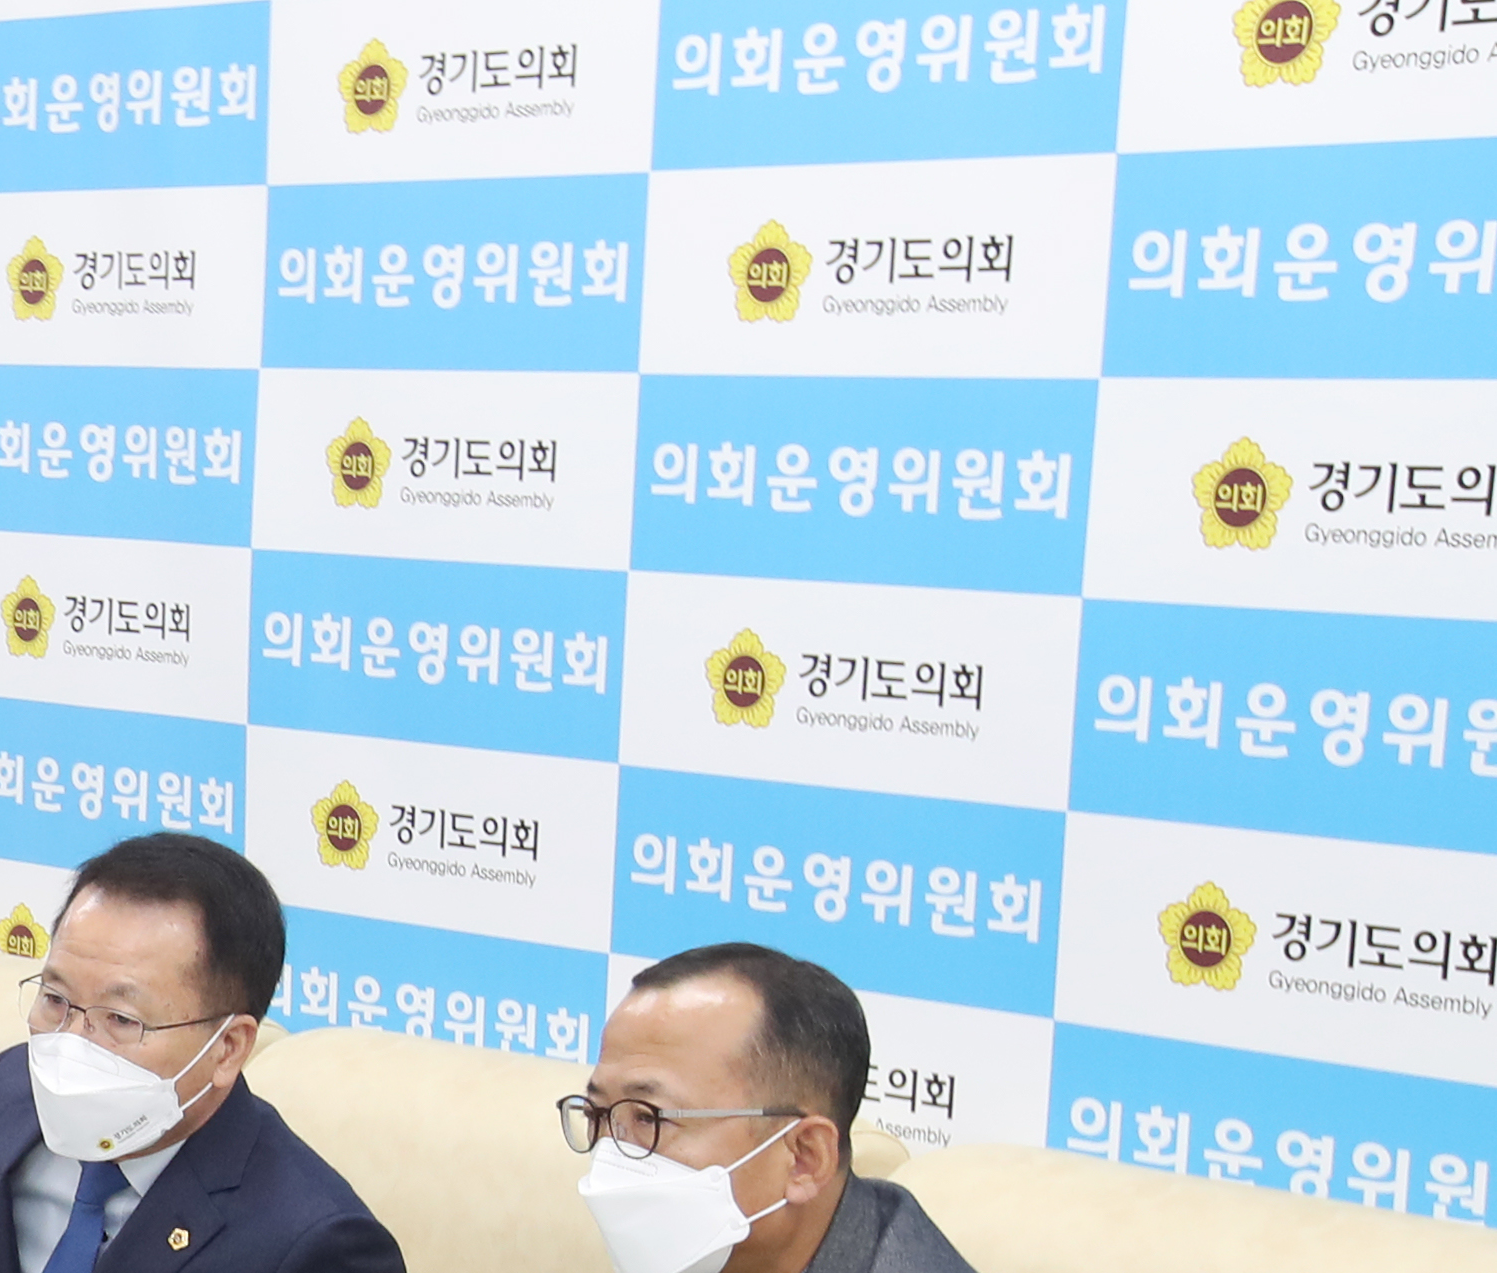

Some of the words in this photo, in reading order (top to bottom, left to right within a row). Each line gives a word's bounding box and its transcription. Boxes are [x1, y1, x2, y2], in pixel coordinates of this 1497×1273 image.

[422, 44, 577, 96] 경기도의회
[671, 4, 1105, 95] 의회운영위원회
[1352, 44, 1480, 73] Gyeonggido
[417, 105, 499, 123] Gyeonggido
[506, 101, 572, 118] Assembly
[76, 250, 195, 290] 경기도의회
[277, 238, 630, 310] 의회운영위원회
[827, 235, 1013, 285] 경기도의회
[72, 298, 139, 316] Gyeonggido
[143, 300, 192, 315] Assembly
[823, 295, 921, 316] Gyeonggido
[928, 295, 1005, 313] Assembly
[402, 437, 557, 482] 경기도의회
[650, 441, 1073, 521] 의회운영위원회
[400, 486, 482, 508] Gyeonggido
[487, 490, 552, 509] Assembly
[1304, 522, 1428, 549] Gyeonggido
[64, 596, 190, 642] 경기도의회
[63, 639, 132, 661] Gyeonggido
[135, 646, 189, 668] Assembly
[262, 611, 608, 695] 의회운영위원회
[799, 654, 983, 711] 경기도의회
[796, 706, 894, 732] Gyeonggido
[899, 715, 980, 742] Assembly
[390, 805, 539, 862] 경기도의회
[387, 851, 467, 878] Gyeonggido
[470, 860, 538, 889] Assembly
[630, 833, 1042, 944] 의회운영위원회
[1273, 913, 1497, 989] 경기도의회
[1268, 967, 1387, 1003] Gyeonggido
[1392, 983, 1495, 1021] Assembly
